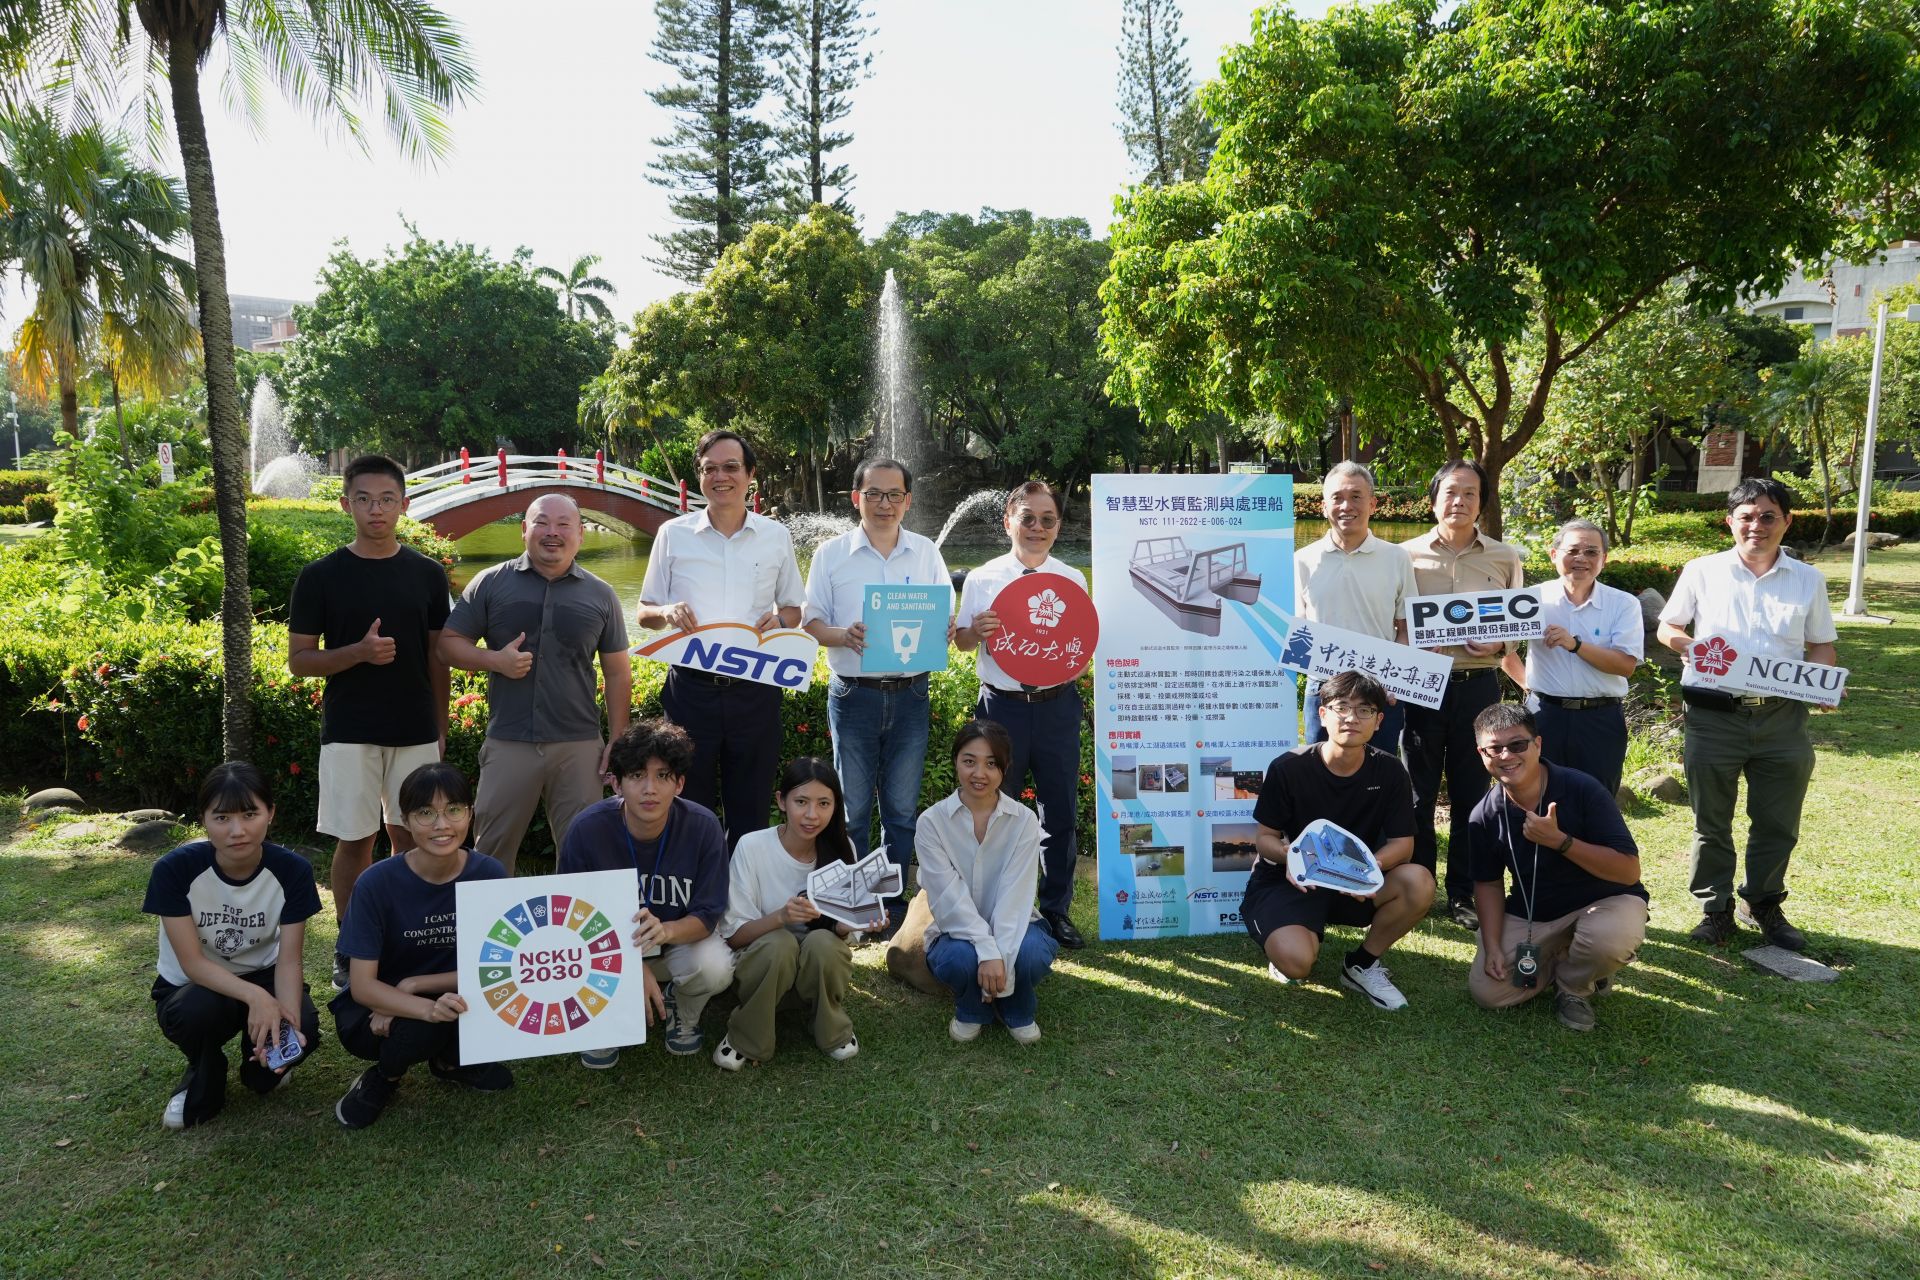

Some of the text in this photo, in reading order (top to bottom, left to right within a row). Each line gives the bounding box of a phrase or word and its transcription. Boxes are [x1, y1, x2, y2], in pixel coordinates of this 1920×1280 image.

[1106, 496, 1283, 512] 智慧型水質監測與處理船
[1139, 517, 1243, 526] NSTC 111-2622-E-006-024
[871, 591, 881, 610] 6
[887, 592, 928, 600] CLEAN WATER
[886, 602, 936, 612] AND SANITATION
[1412, 594, 1540, 628] PCEC
[1446, 634, 1482, 643] Engineering
[1483, 632, 1519, 641] Consultants
[680, 637, 808, 687] NSTC
[1106, 659, 1140, 668] 特色說明
[1319, 643, 1445, 693] 中信造船集團
[1702, 676, 1716, 684] 1931
[1747, 656, 1843, 691] NCKU
[1314, 665, 1334, 676] JONG
[1412, 692, 1439, 704] GROUP
[1745, 682, 1836, 704] National Cheng Kung University
[1108, 731, 1141, 740] 應用實績
[222, 904, 243, 916] TOP
[425, 912, 457, 924] I CAN'T
[198, 911, 266, 928] DEFENDER
[429, 936, 456, 945] FLATS
[519, 947, 583, 967] NCKU
[520, 963, 583, 984] 2030
